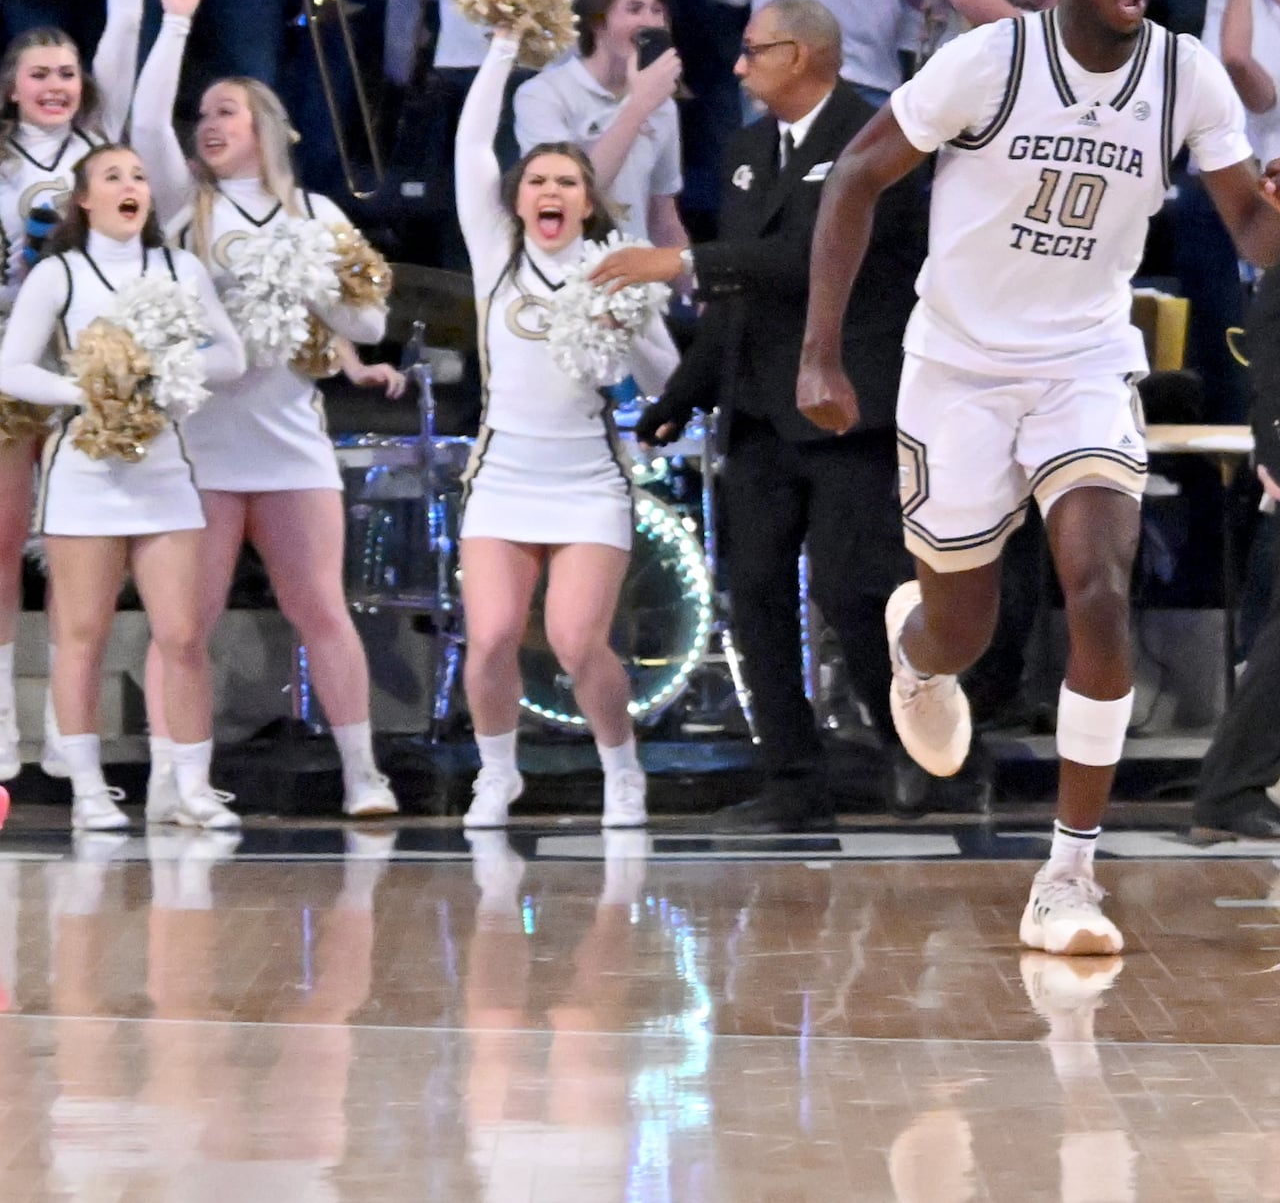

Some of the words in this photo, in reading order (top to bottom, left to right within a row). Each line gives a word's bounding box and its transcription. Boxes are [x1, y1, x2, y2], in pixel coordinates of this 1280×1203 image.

[1008, 135, 1143, 177] GEORGIA
[1024, 167, 1108, 230] 10
[1010, 223, 1097, 260] TECH
